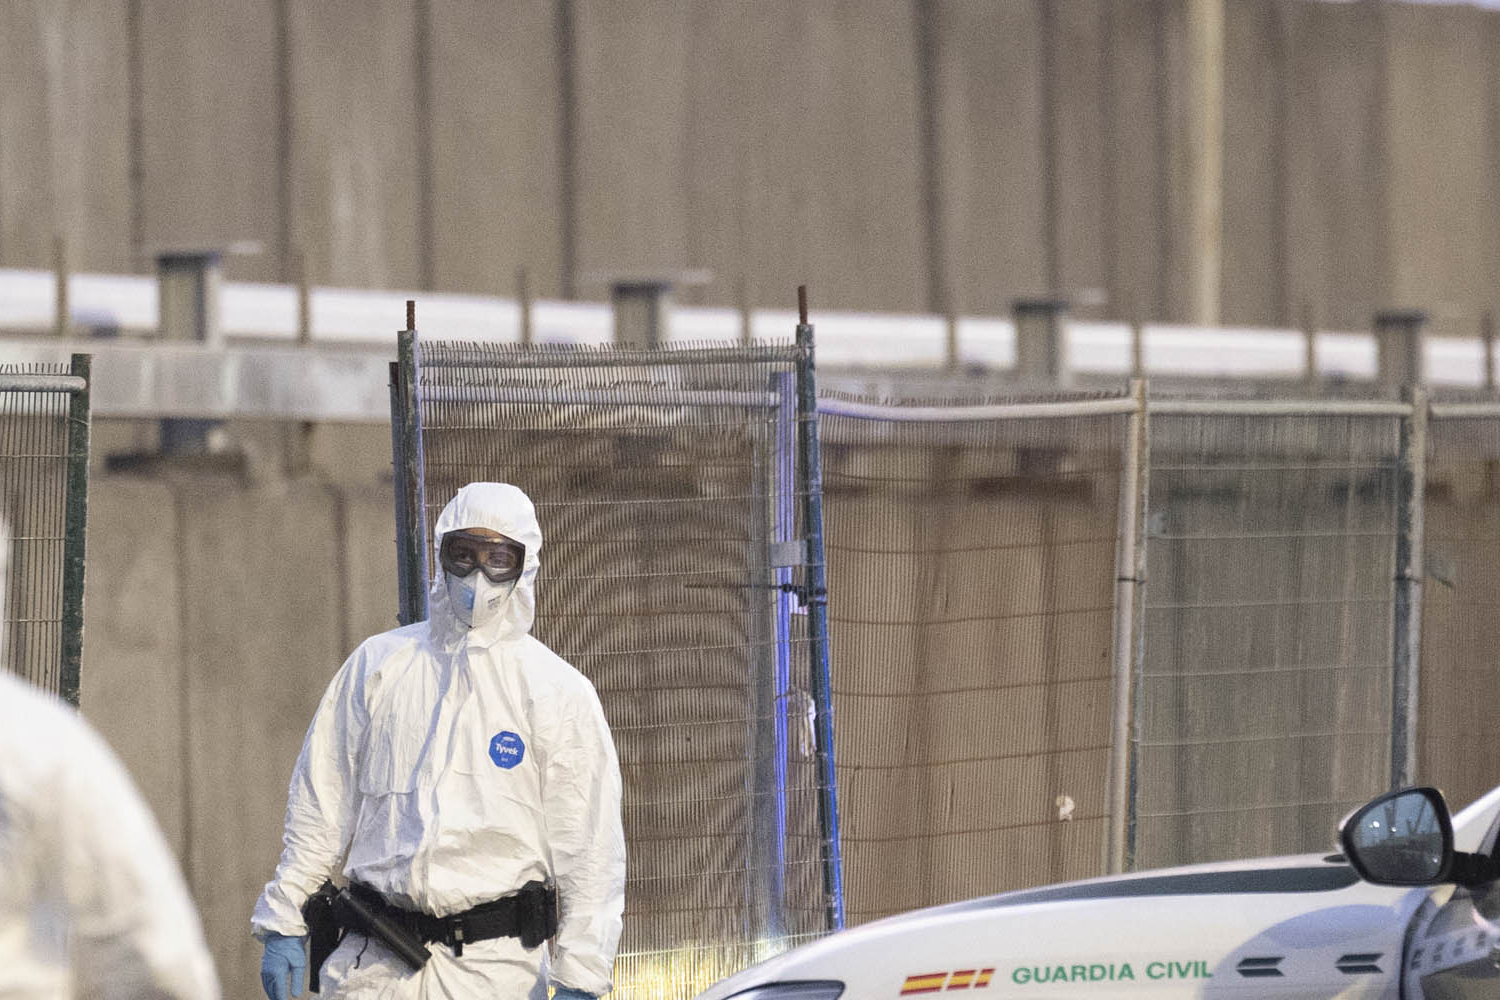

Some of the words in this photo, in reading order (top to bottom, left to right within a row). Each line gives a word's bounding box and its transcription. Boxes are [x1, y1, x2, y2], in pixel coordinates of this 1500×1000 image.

[496, 743, 518, 756] Tyvek
[1011, 962, 1136, 985] GUARDIA
[1145, 960, 1214, 980] CIVIL
